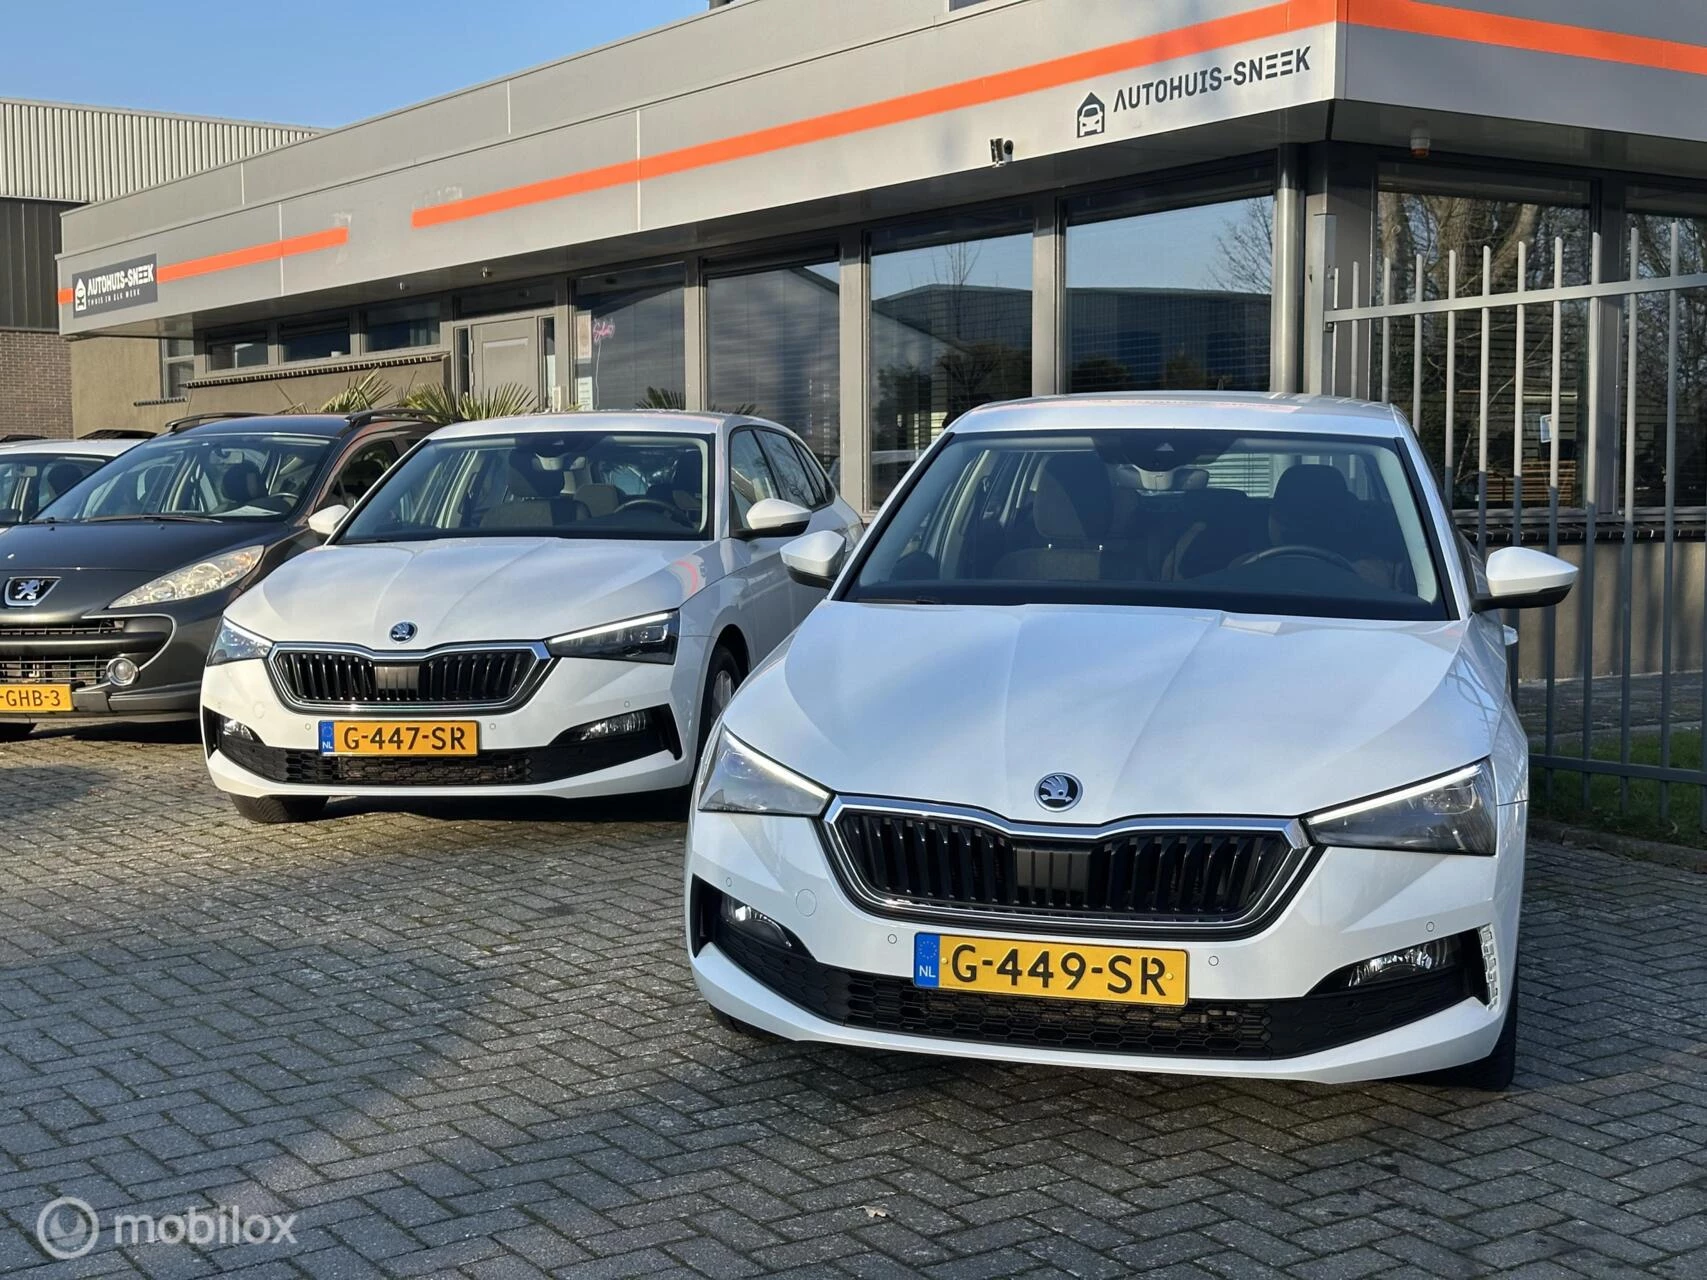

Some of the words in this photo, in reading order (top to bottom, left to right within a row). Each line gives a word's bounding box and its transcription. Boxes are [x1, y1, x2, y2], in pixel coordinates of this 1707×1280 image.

[1113, 46, 1311, 112] AUTOHUIS-SNEEK
[87, 264, 154, 296] AUTOHUIS-SNEEK
[322, 741, 333, 749] NL
[343, 727, 466, 750] G-447-SR
[919, 965, 936, 978] NL
[951, 944, 1166, 996] G-449-SR
